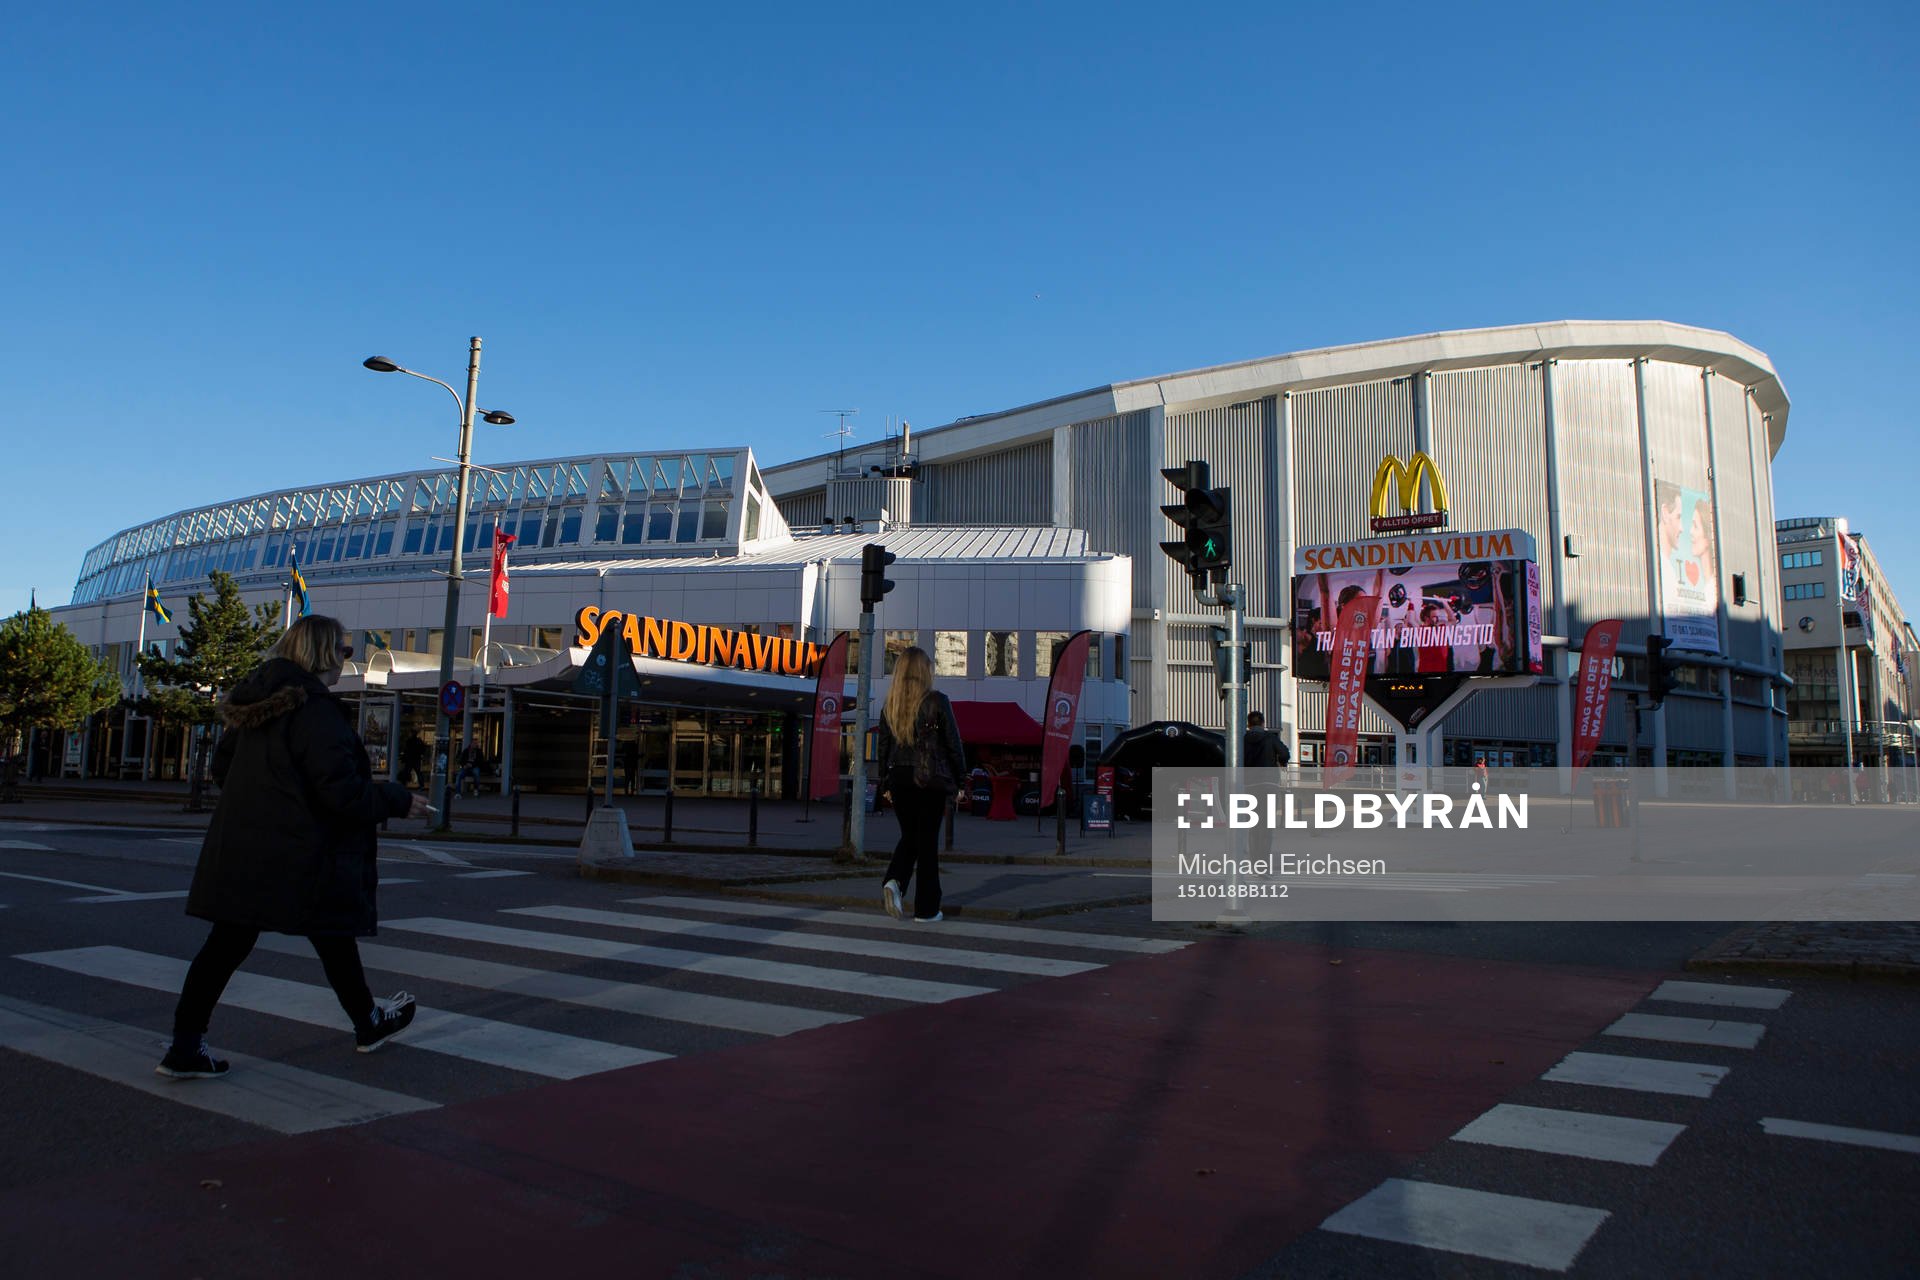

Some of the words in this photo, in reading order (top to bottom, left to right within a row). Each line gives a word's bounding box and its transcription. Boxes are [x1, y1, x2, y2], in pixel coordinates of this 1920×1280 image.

[1305, 534, 1515, 571] SCANDINAVIUM
[1382, 517, 1410, 528] ALLTID
[1400, 623, 1494, 649] BINDNINGSTID
[1335, 695, 1347, 728] IDAG
[1341, 638, 1354, 667] DET
[1346, 640, 1367, 730] MATCH
[1580, 706, 1592, 737] IDAG
[1587, 656, 1600, 682] DET
[1590, 658, 1611, 738] MATCH
